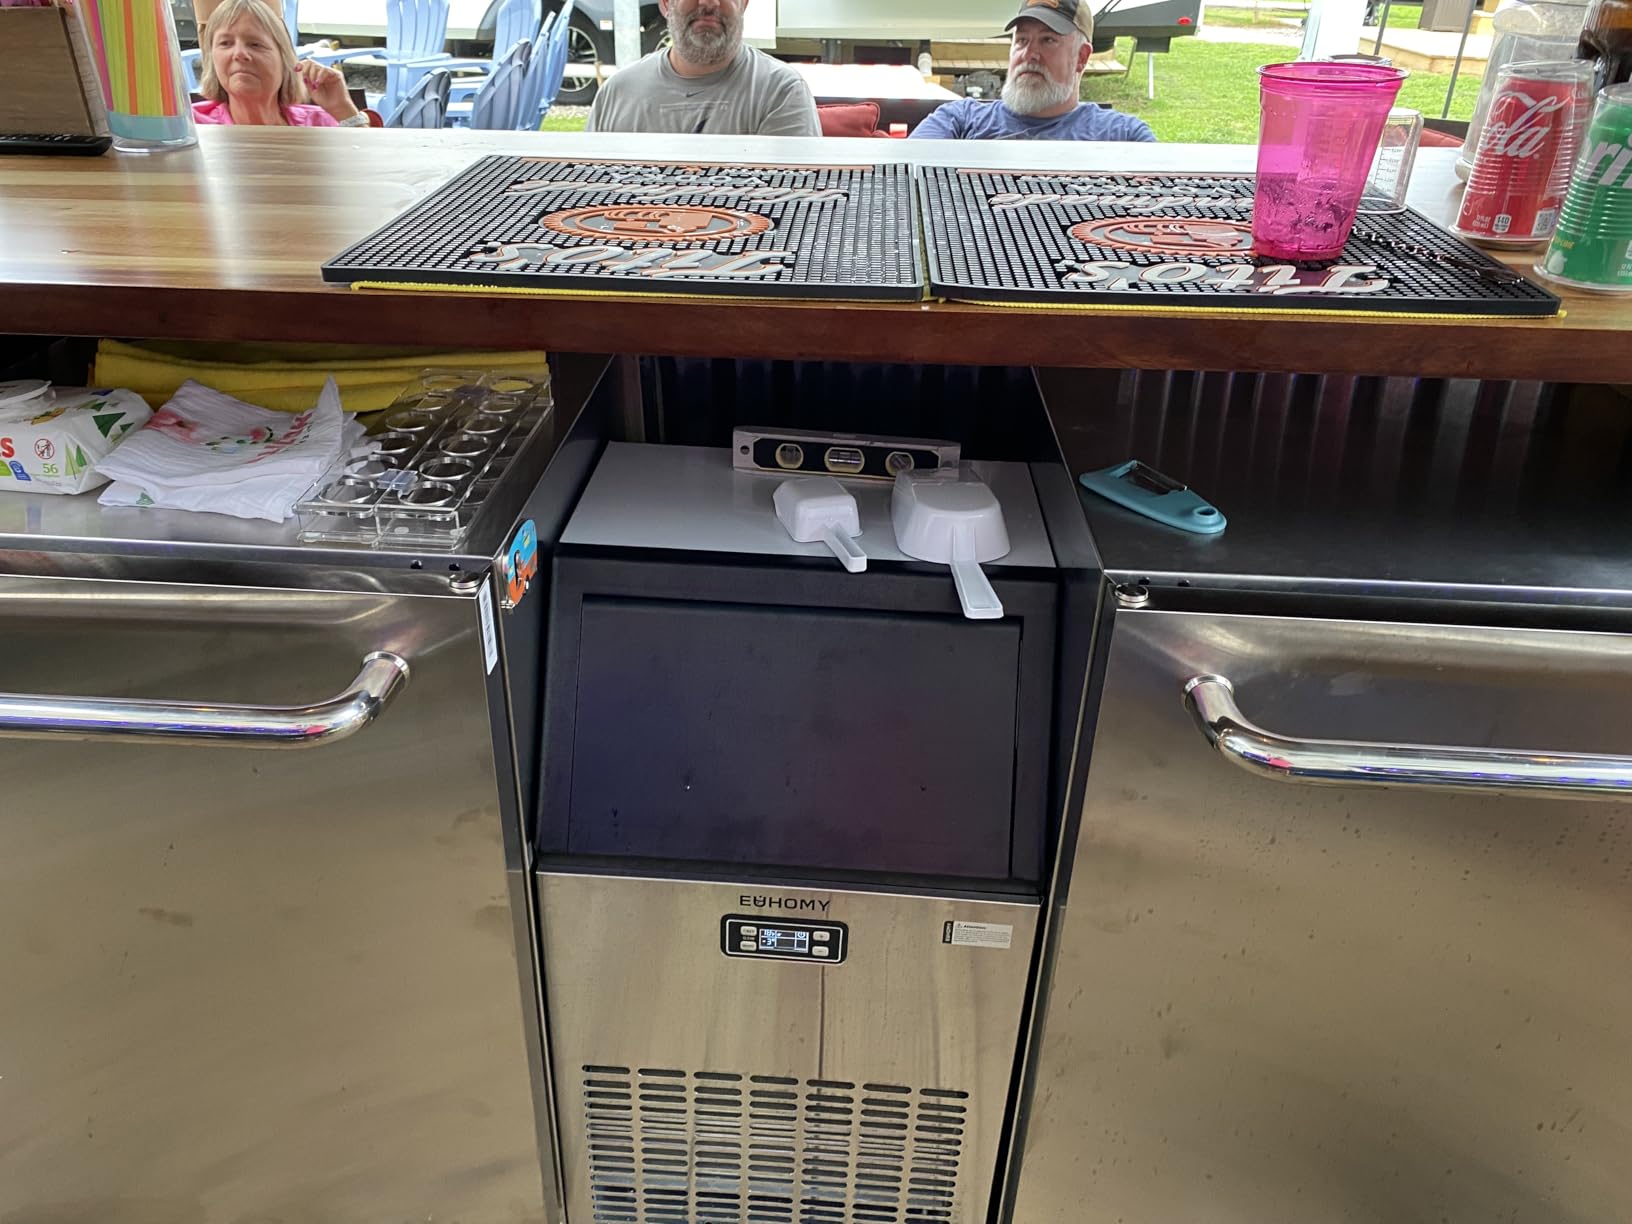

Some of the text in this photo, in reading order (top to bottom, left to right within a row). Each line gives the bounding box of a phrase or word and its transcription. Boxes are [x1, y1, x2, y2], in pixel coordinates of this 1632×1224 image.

[987, 192, 1255, 212] andmade
[468, 242, 793, 278] Tito's
[1061, 262, 1389, 294] Tito's
[42, 463, 59, 474] 56
